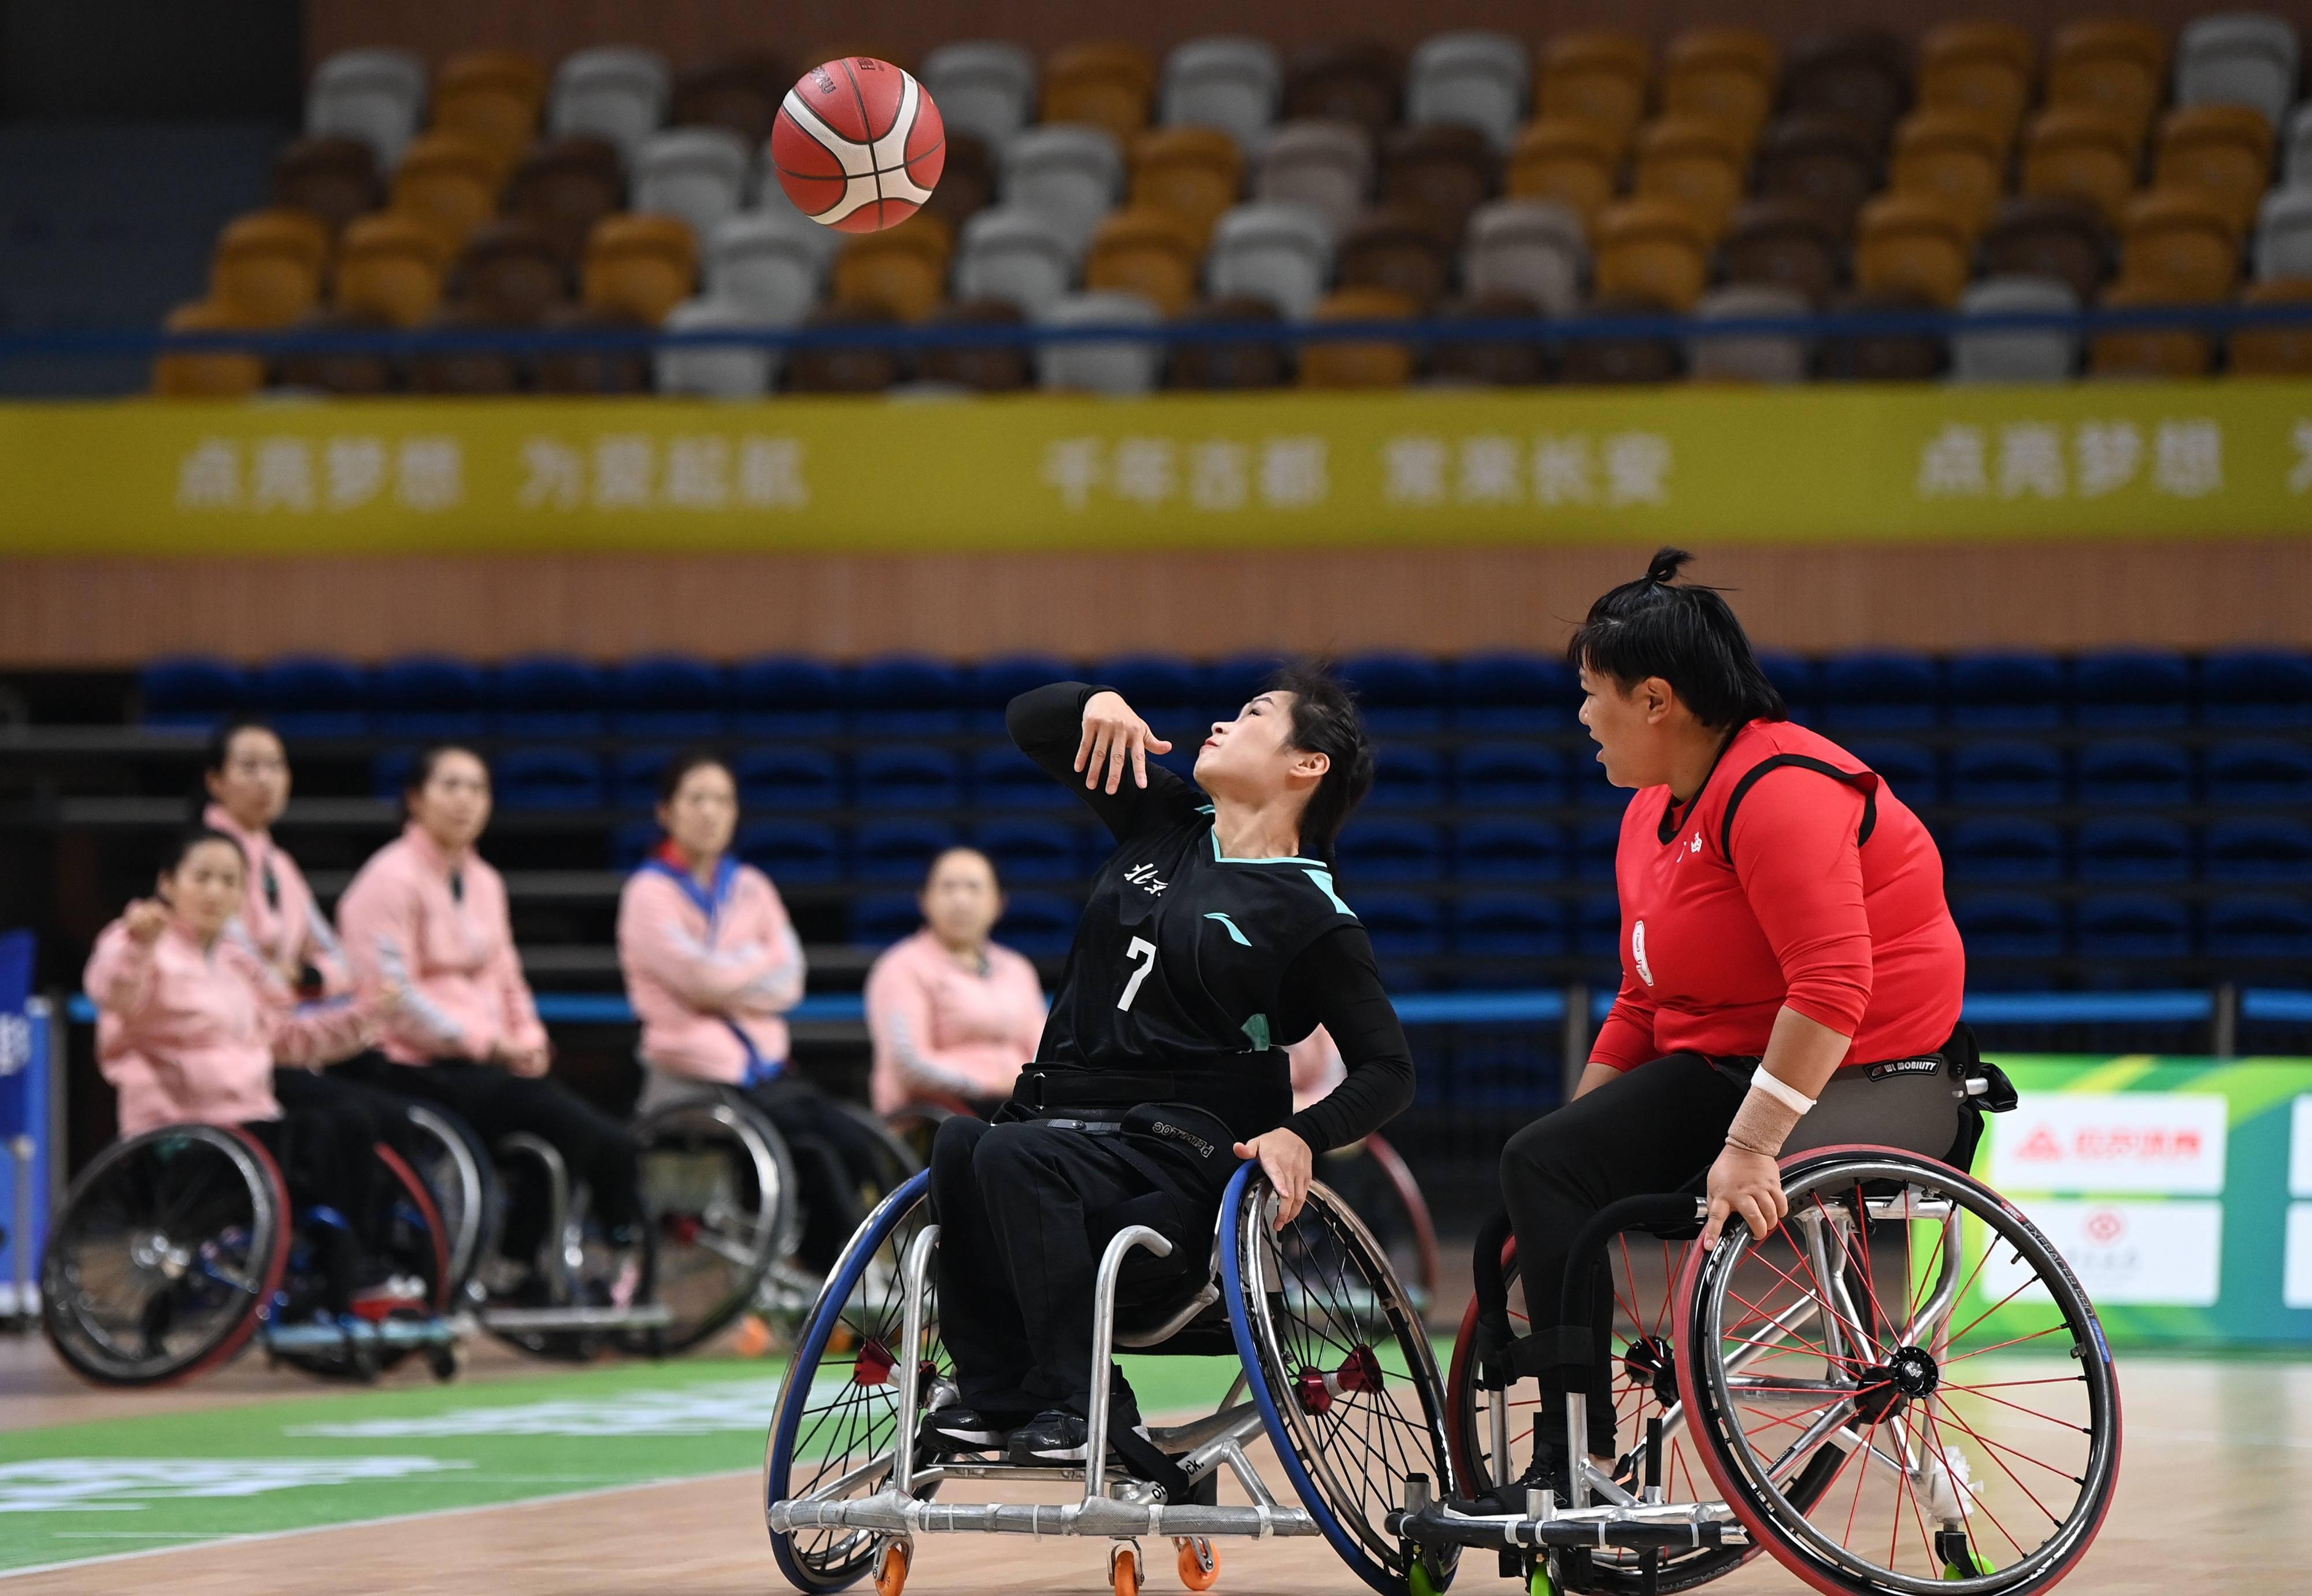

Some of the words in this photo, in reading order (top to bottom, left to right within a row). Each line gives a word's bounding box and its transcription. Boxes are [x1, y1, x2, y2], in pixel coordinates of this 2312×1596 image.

[1046, 439, 1325, 507] 千年古都
[1920, 424, 2220, 496] 点亮梦想
[1124, 863, 1168, 897] 北京
[1117, 936, 1156, 1012] 7
[1632, 920, 1654, 986] 9
[1897, 1061, 1936, 1071] MOBILITY
